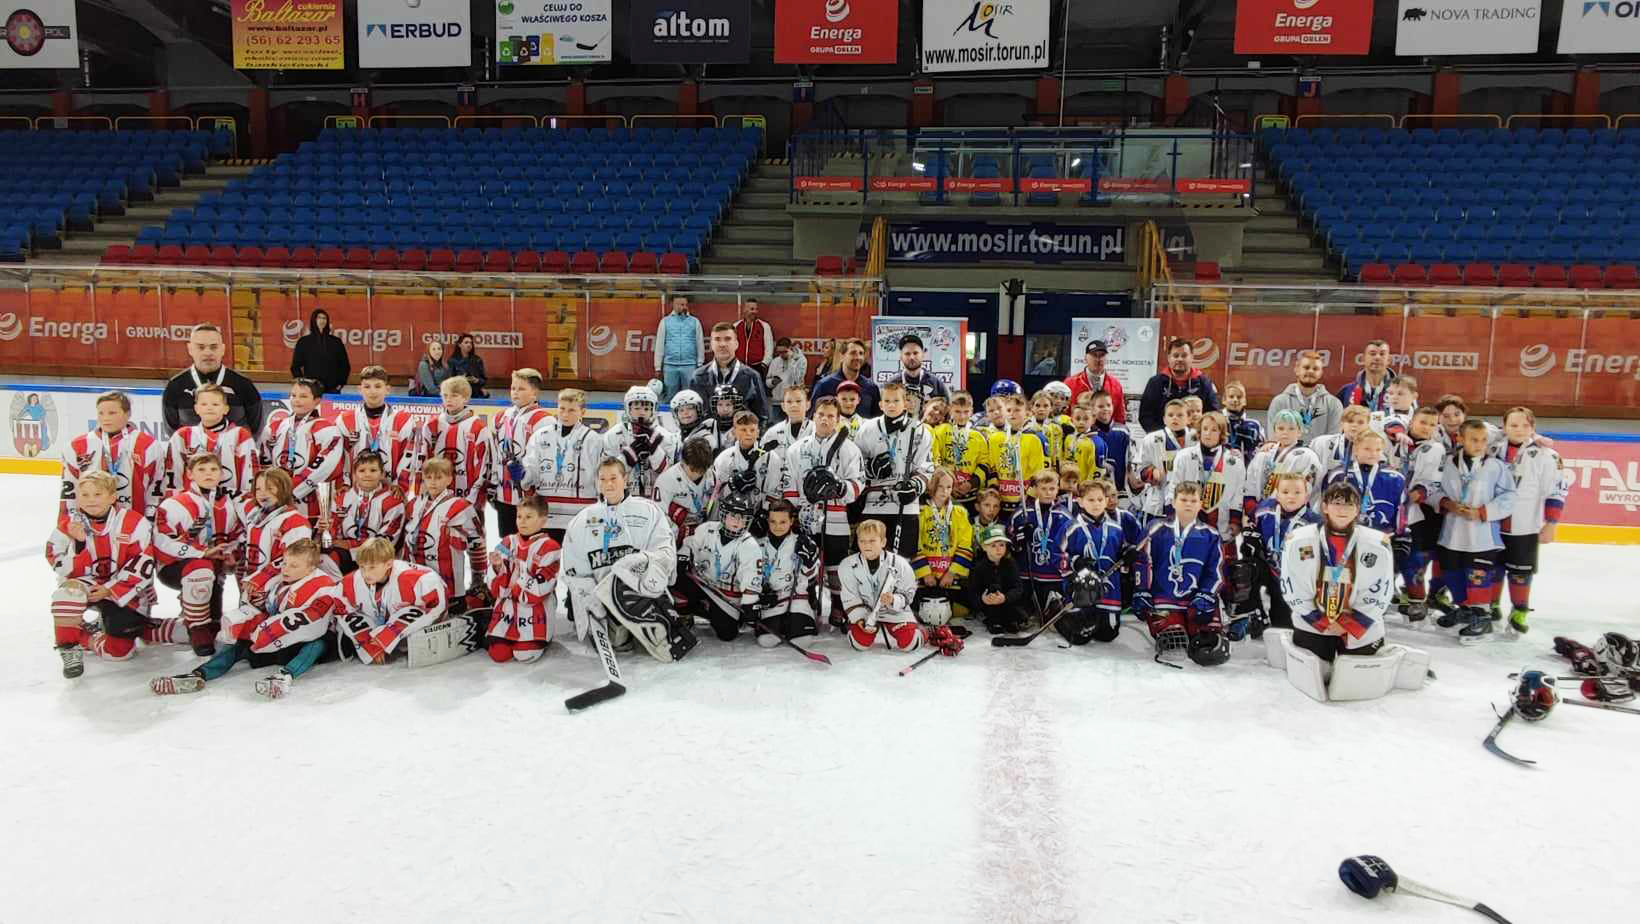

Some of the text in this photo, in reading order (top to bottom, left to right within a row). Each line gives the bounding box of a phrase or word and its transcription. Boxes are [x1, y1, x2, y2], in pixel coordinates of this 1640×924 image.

[543, 3, 583, 12] CELUJ DO
[1430, 7, 1536, 20] NOVA TRADING
[521, 13, 607, 24] WŁAŚCIWEGO KOSZA
[653, 10, 730, 38] altom
[1274, 13, 1332, 31] Energa
[391, 22, 462, 38] ERBUD
[810, 26, 863, 43] Energa
[247, 35, 340, 46] (56) 62 293 65
[1273, 35, 1301, 44] GRUPA
[810, 46, 834, 54] GRUPA
[924, 39, 1046, 65] www.mosir.torun.pl
[892, 229, 1123, 261] www.mosir.torun.pl
[30, 316, 108, 345] Energa
[127, 326, 171, 338] GRUPA
[474, 333, 520, 346] ORLEN
[1229, 342, 1331, 368] Enera
[1418, 353, 1473, 367] ORLEN
[60, 480, 76, 500] 2
[123, 554, 156, 580] 10
[1368, 578, 1390, 597] 31
[282, 611, 311, 632] 3
[596, 630, 620, 680] BAUER
